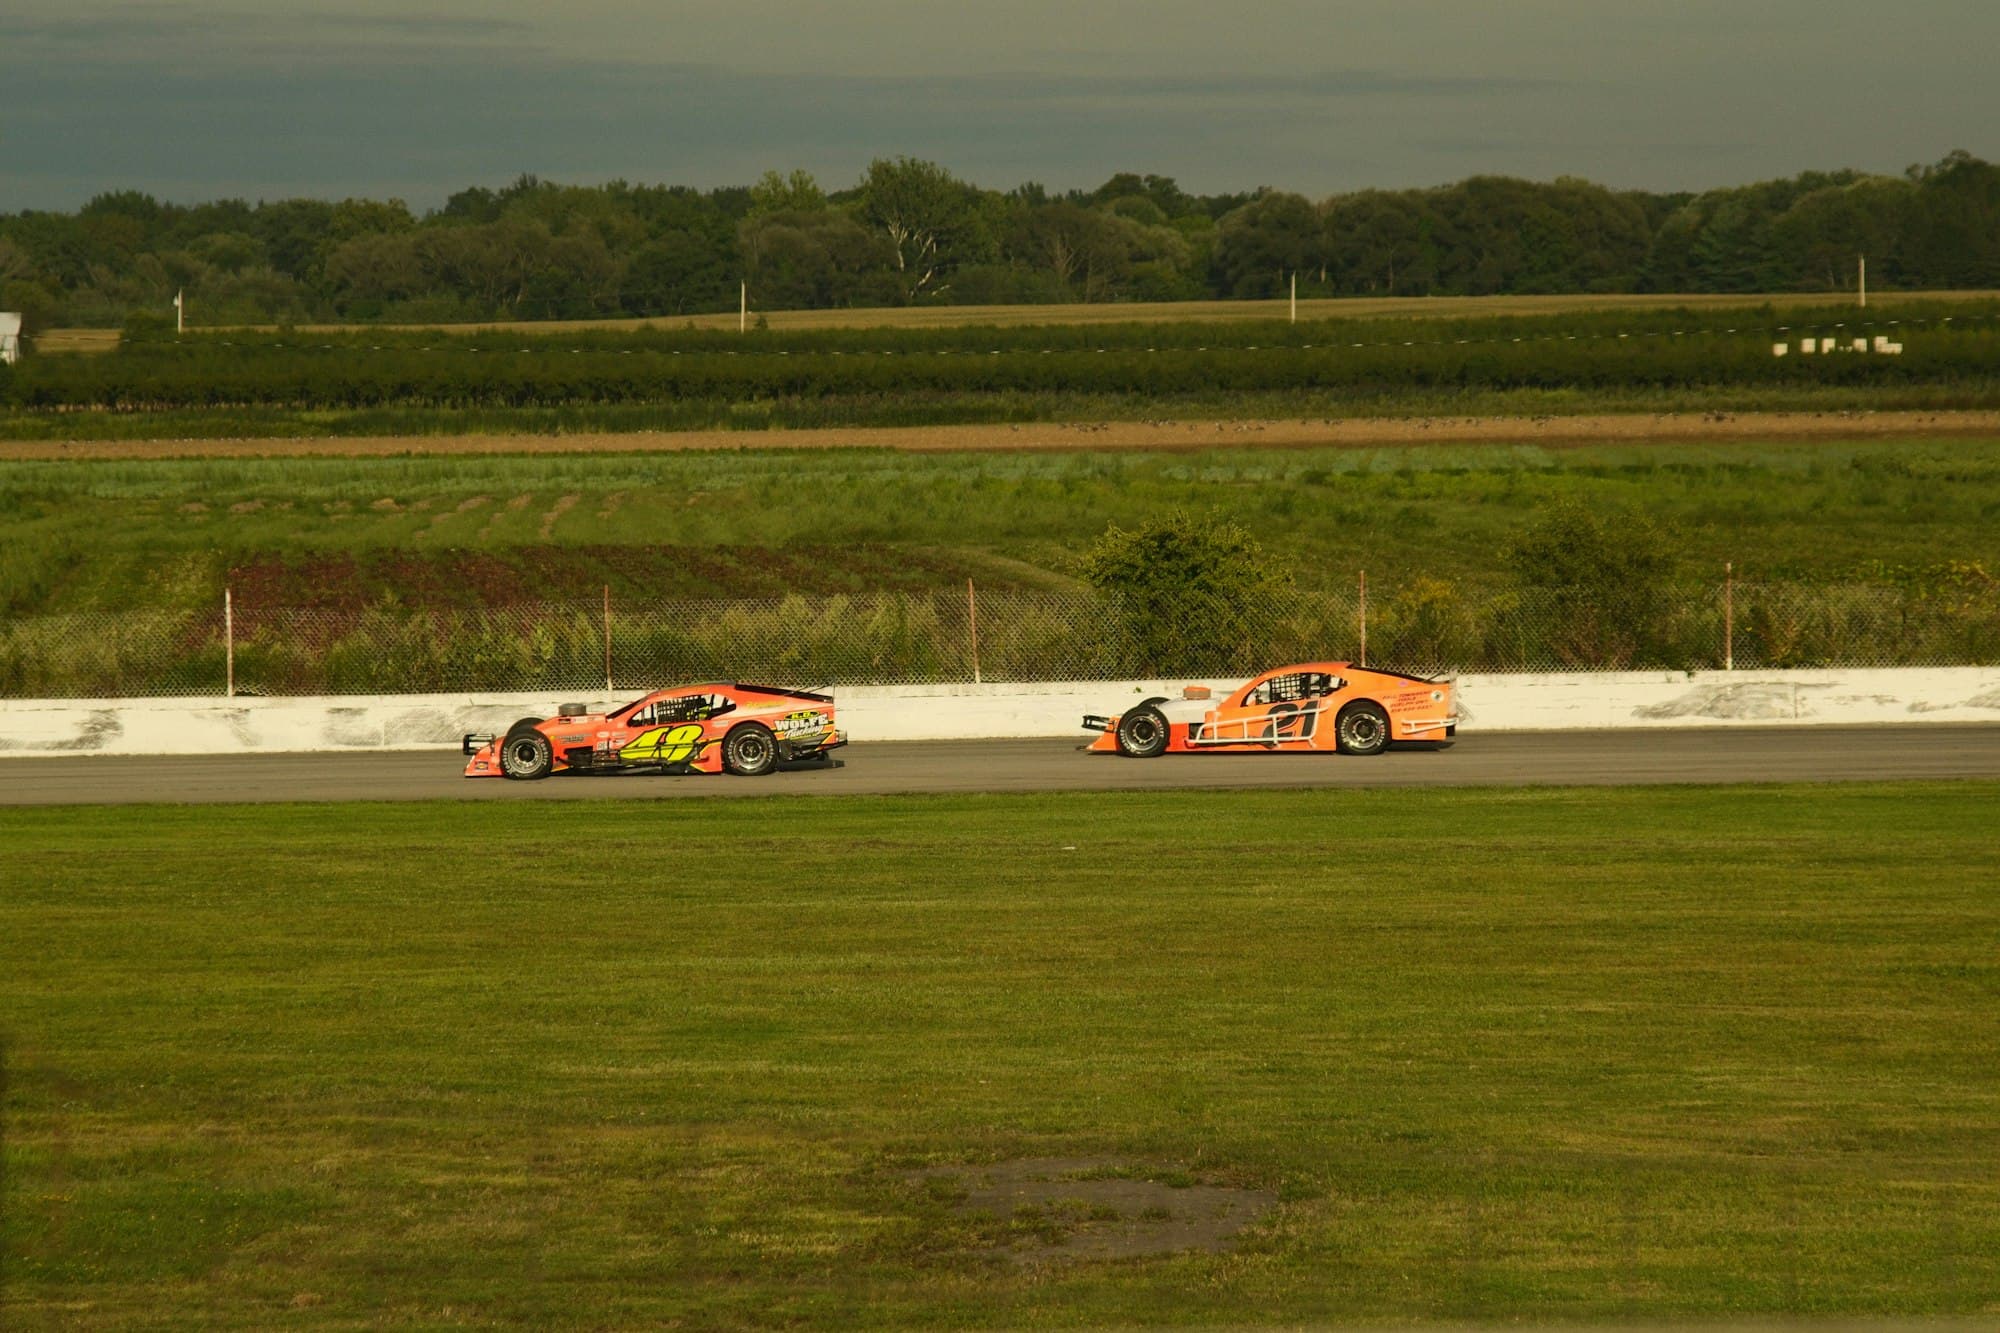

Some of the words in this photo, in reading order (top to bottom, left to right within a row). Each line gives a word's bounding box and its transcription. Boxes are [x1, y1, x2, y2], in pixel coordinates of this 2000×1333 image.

[774, 713, 828, 731] WOLFE
[1262, 701, 1319, 739] 21
[619, 724, 704, 762] 48
